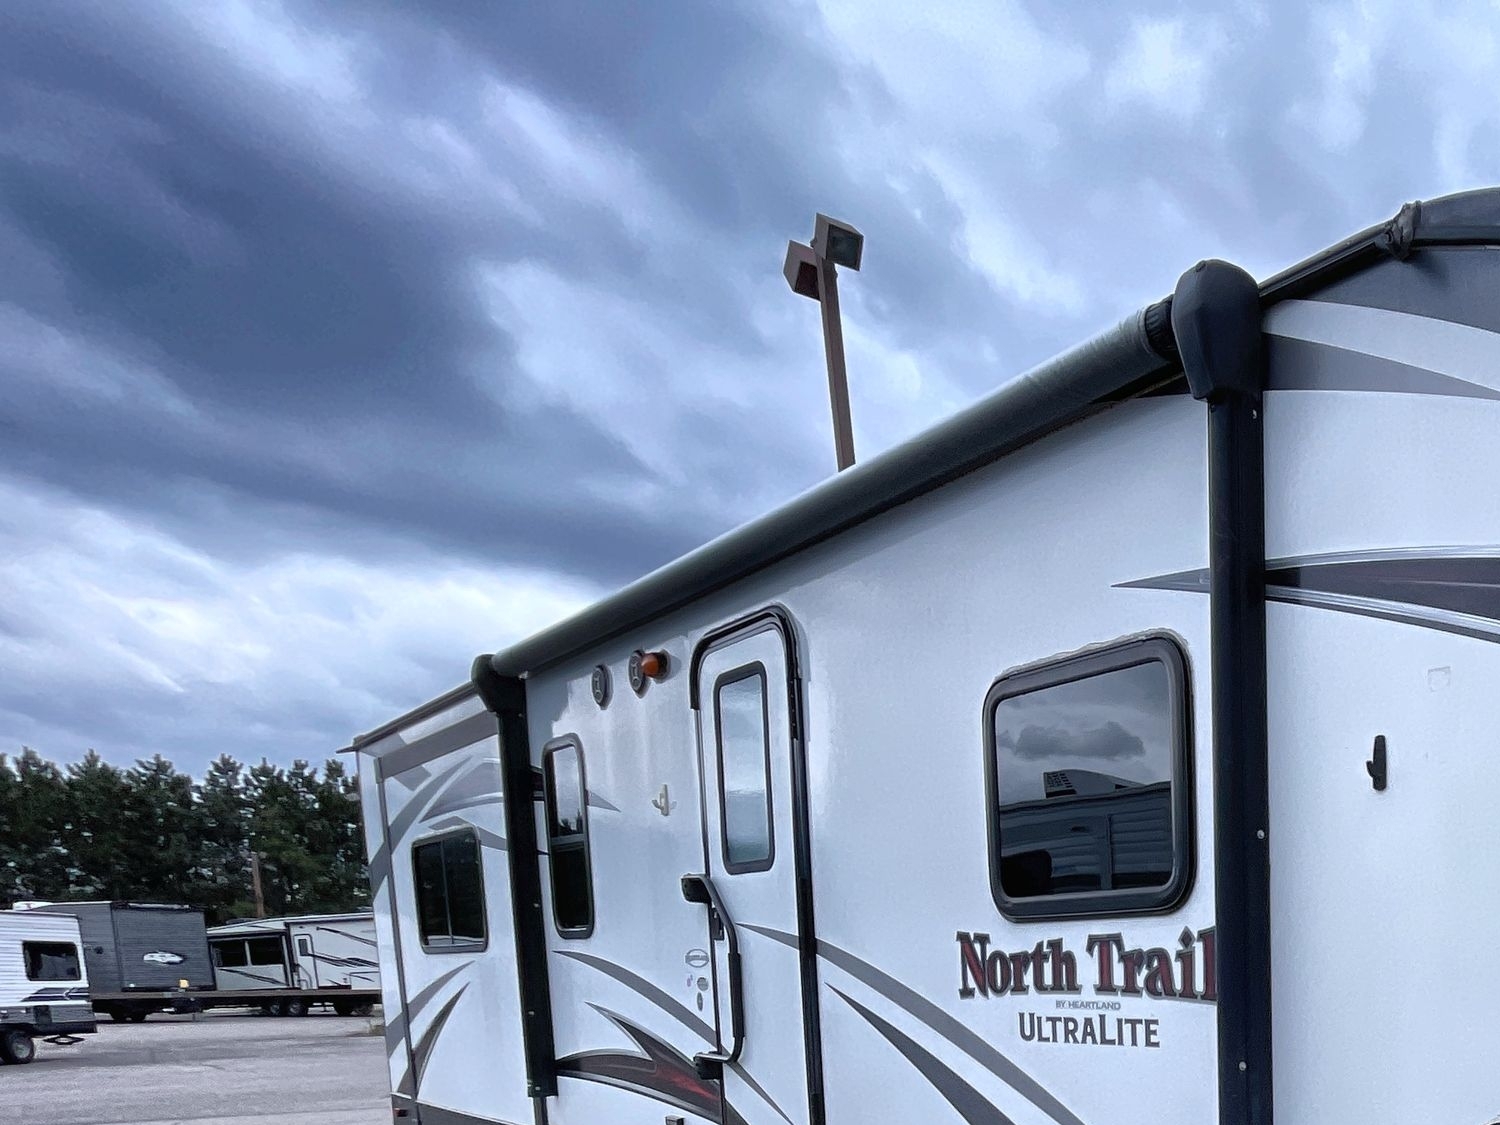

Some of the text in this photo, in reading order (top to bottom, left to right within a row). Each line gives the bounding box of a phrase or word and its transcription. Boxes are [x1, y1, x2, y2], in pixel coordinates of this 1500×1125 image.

[956, 925, 1217, 1005] North Trail
[1055, 1000, 1121, 1011] BY HEARTLAND
